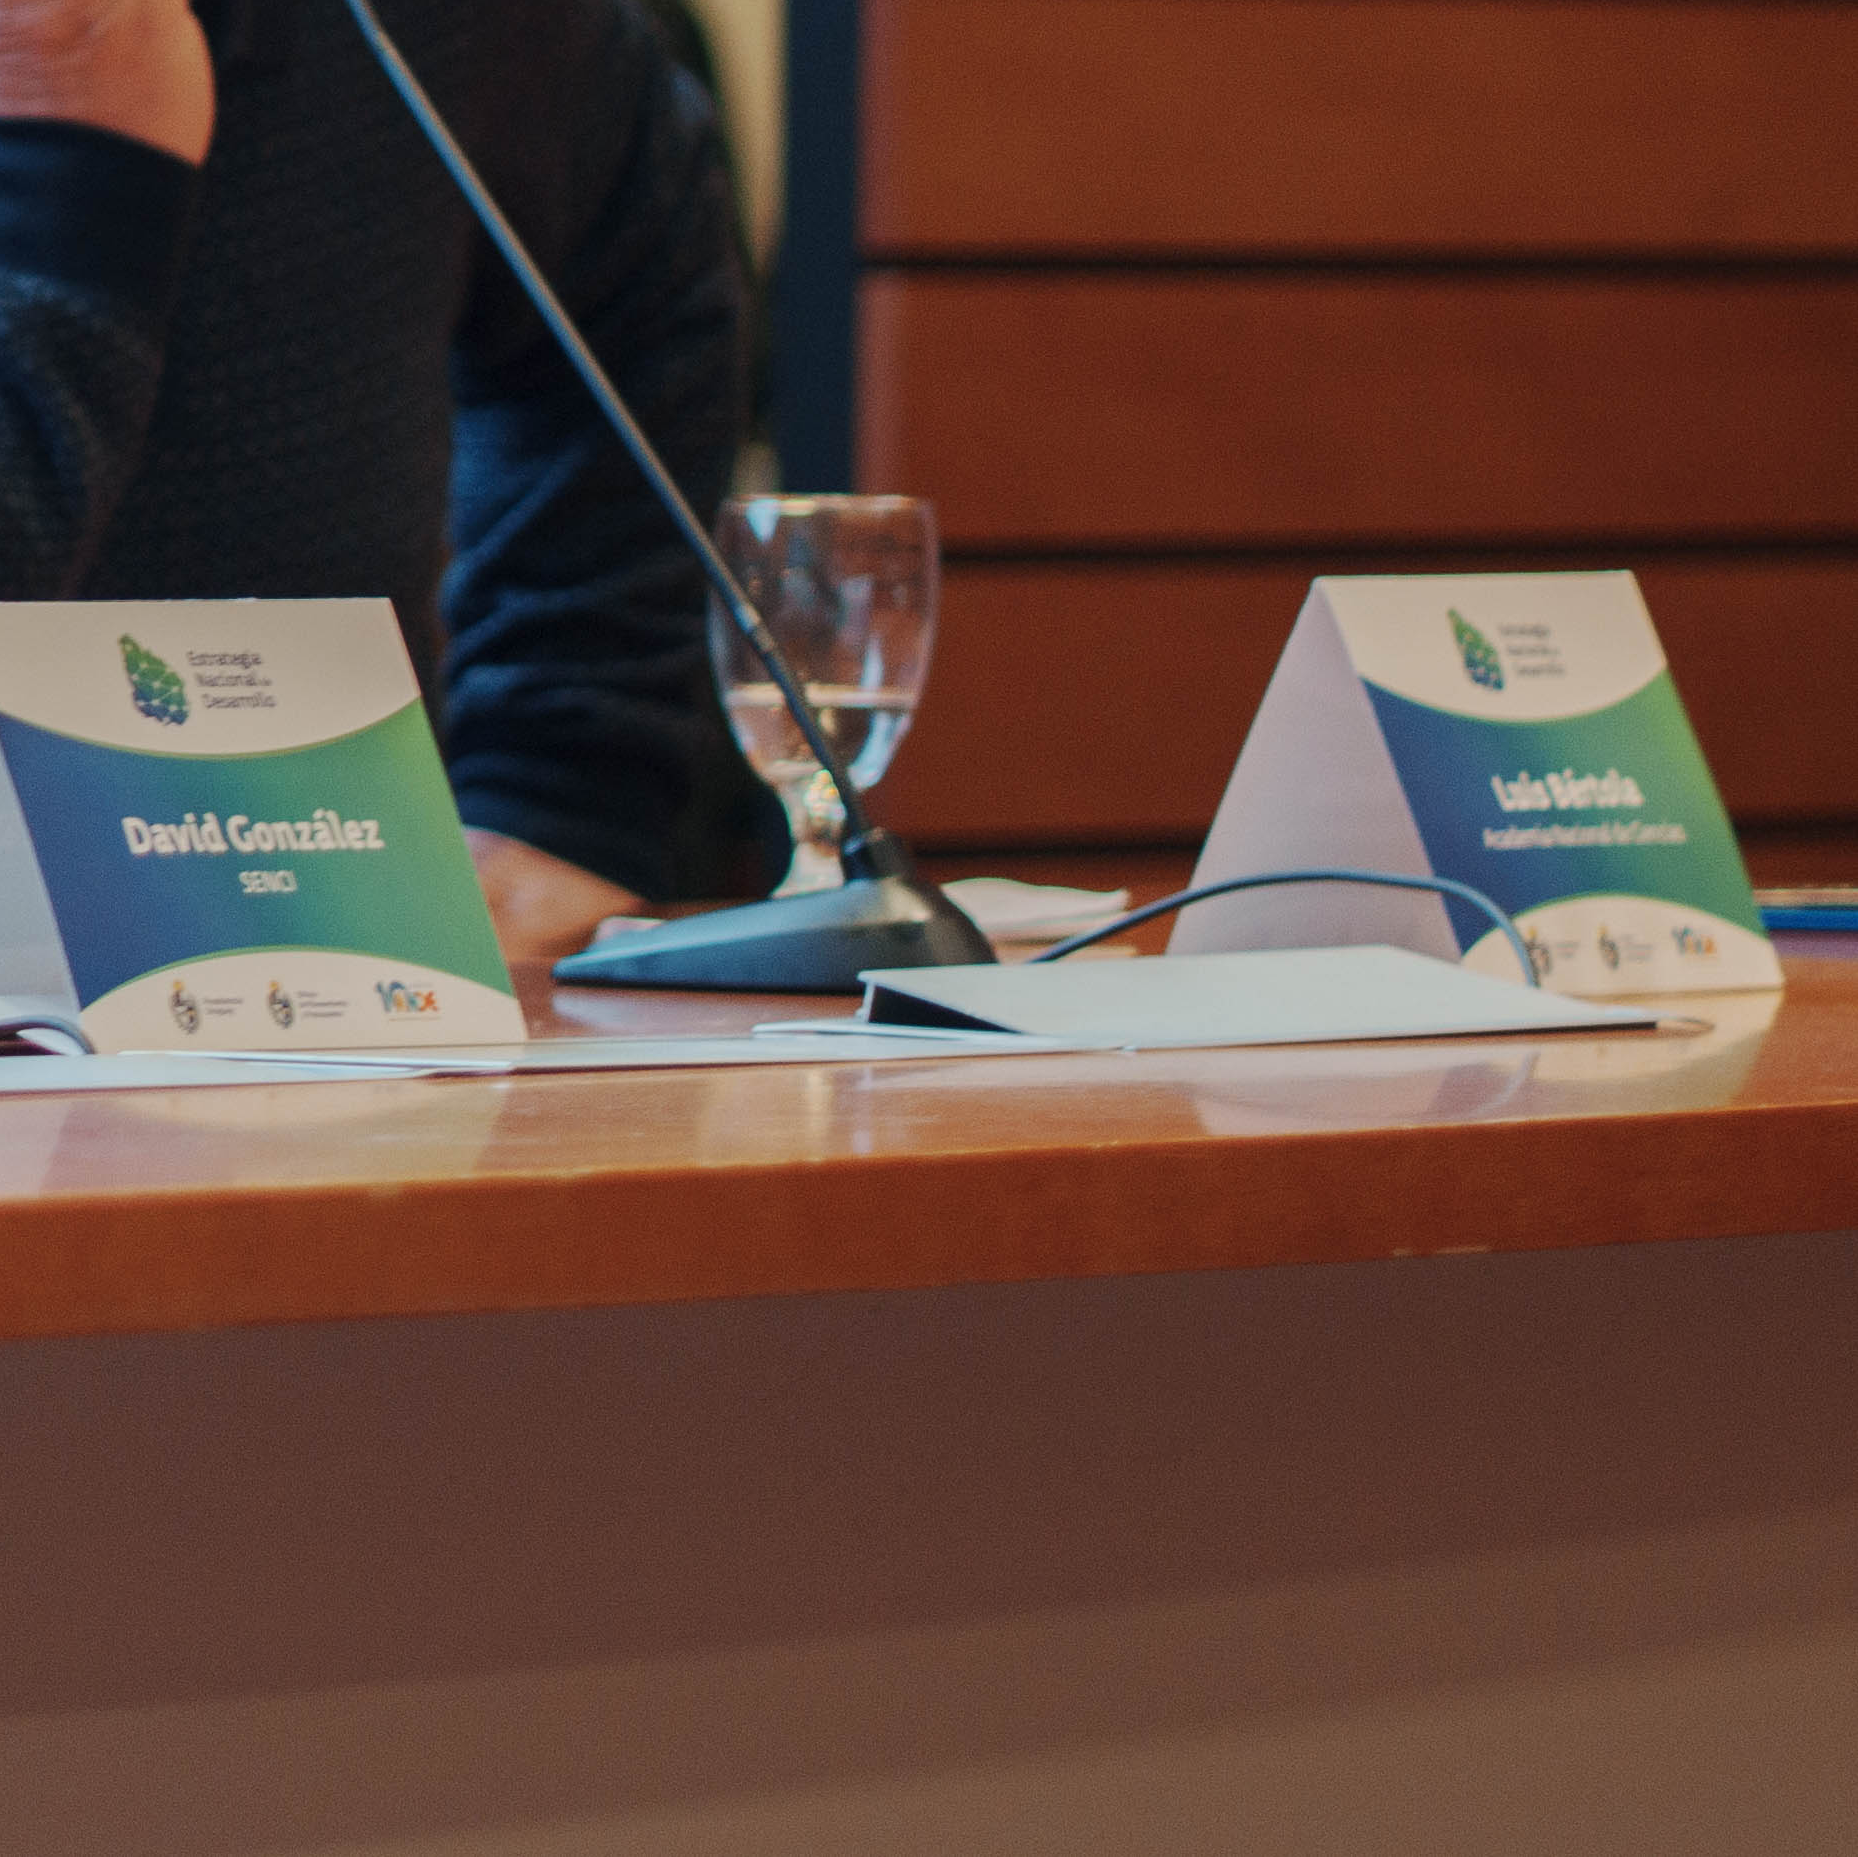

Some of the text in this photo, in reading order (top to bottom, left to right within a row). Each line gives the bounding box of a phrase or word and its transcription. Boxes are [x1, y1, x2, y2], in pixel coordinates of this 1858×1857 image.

[1490, 769, 1552, 812] Luis
[121, 808, 385, 855] David González
